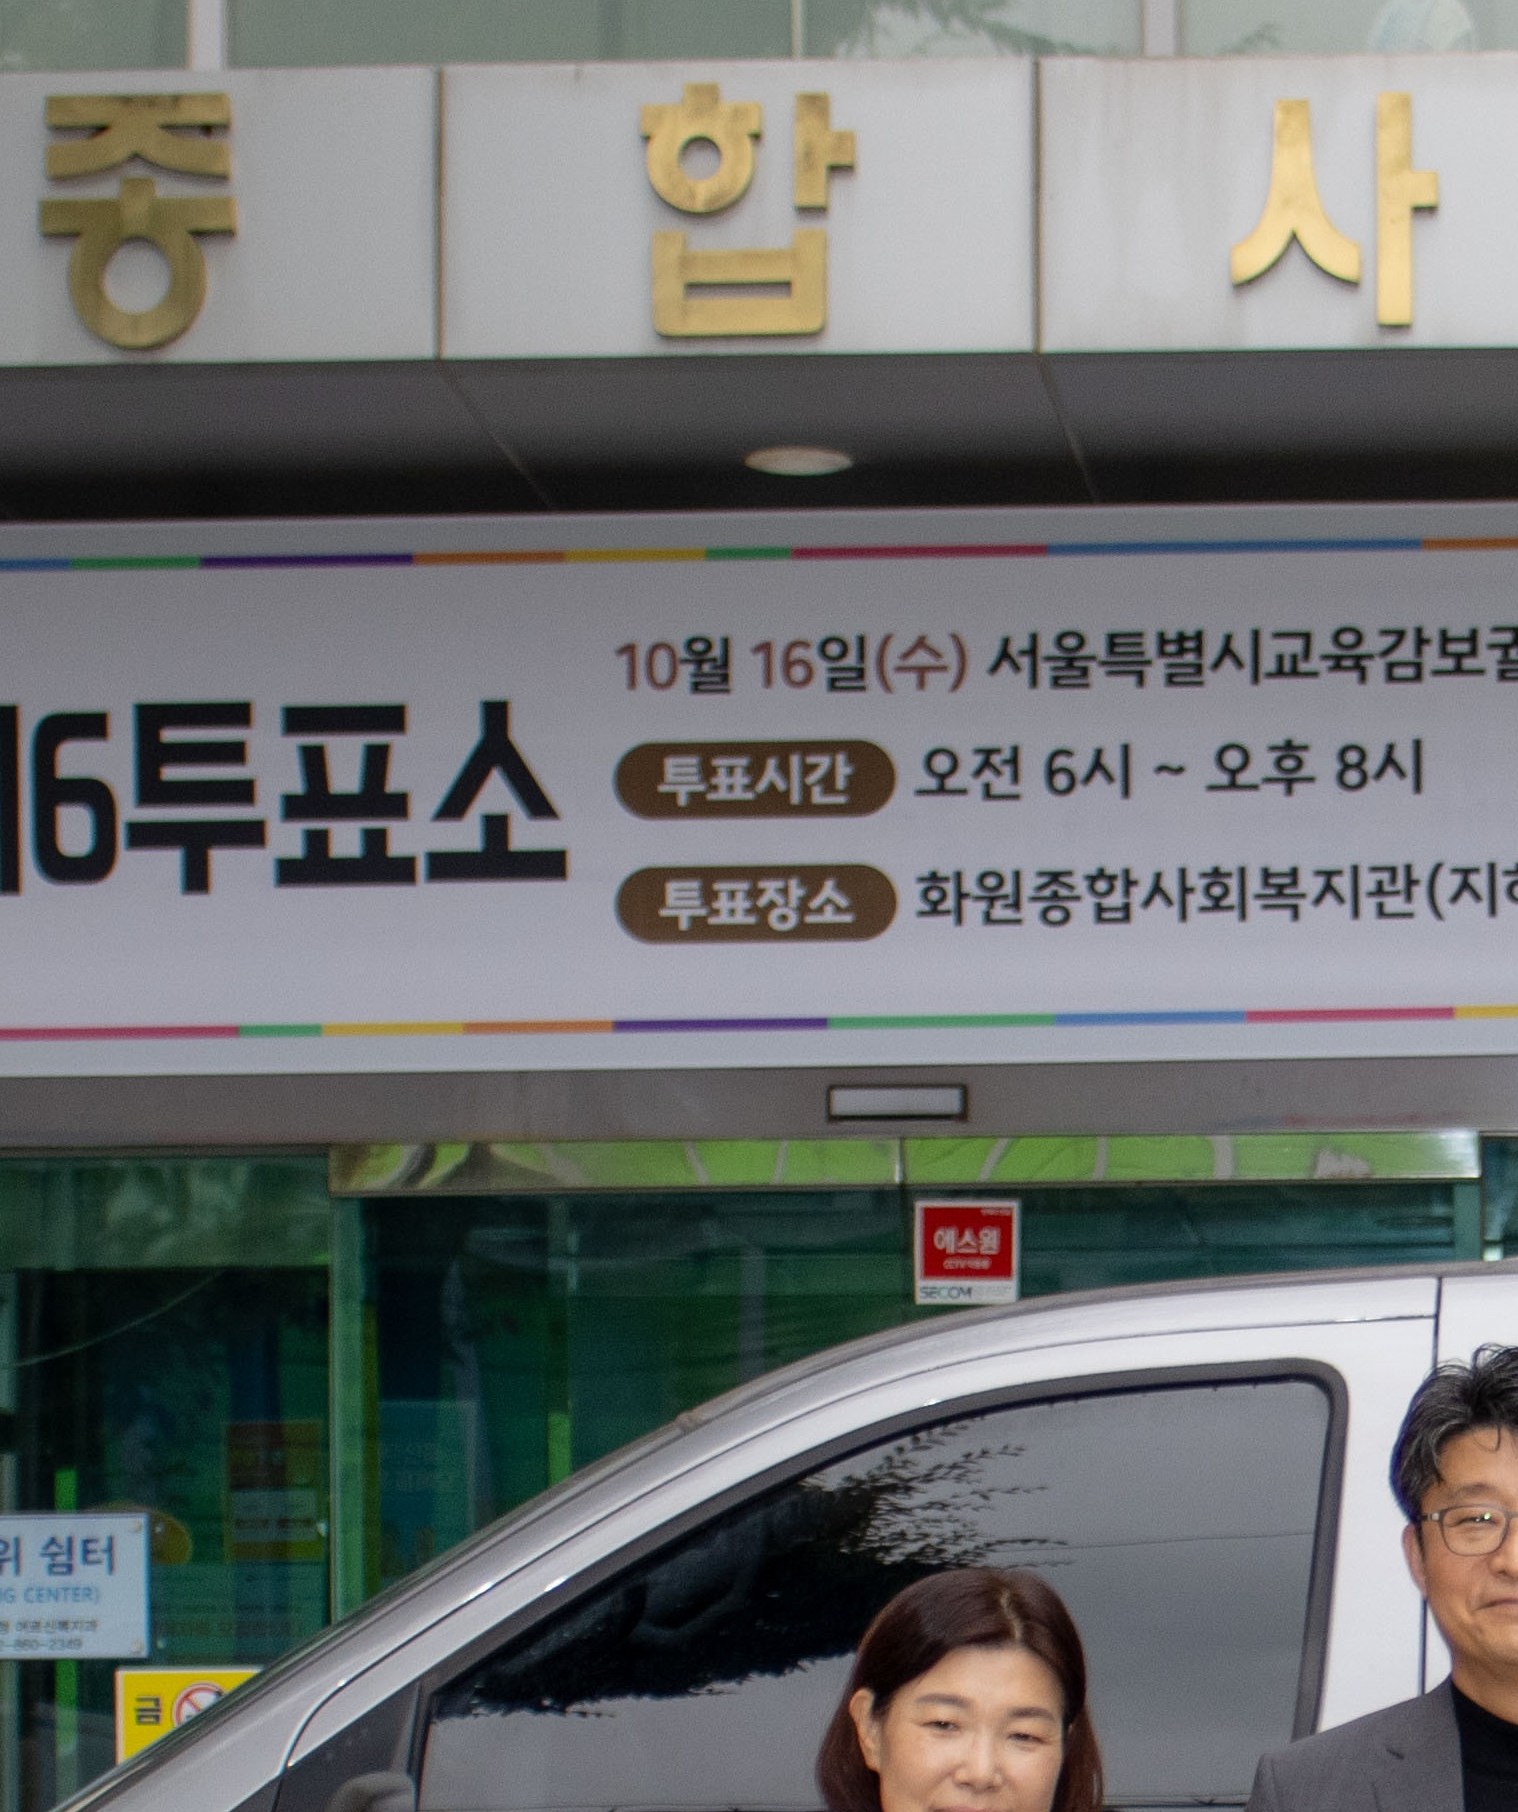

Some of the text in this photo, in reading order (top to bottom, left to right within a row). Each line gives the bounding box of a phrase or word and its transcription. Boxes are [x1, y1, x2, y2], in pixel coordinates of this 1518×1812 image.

[615, 634, 732, 694] 10월
[751, 630, 968, 696] 16일(수)
[658, 752, 853, 808] 투표시간
[915, 744, 1022, 802] 오전
[1043, 744, 1134, 801] 6시
[1206, 740, 1315, 797] 오후
[1335, 738, 1426, 796] 8시
[658, 876, 853, 932] 투표장소
[933, 1226, 1001, 1255] 에스원
[920, 1286, 973, 1299] SECOM
[39, 1534, 116, 1577] 쉼터
[135, 1695, 162, 1726] 금
